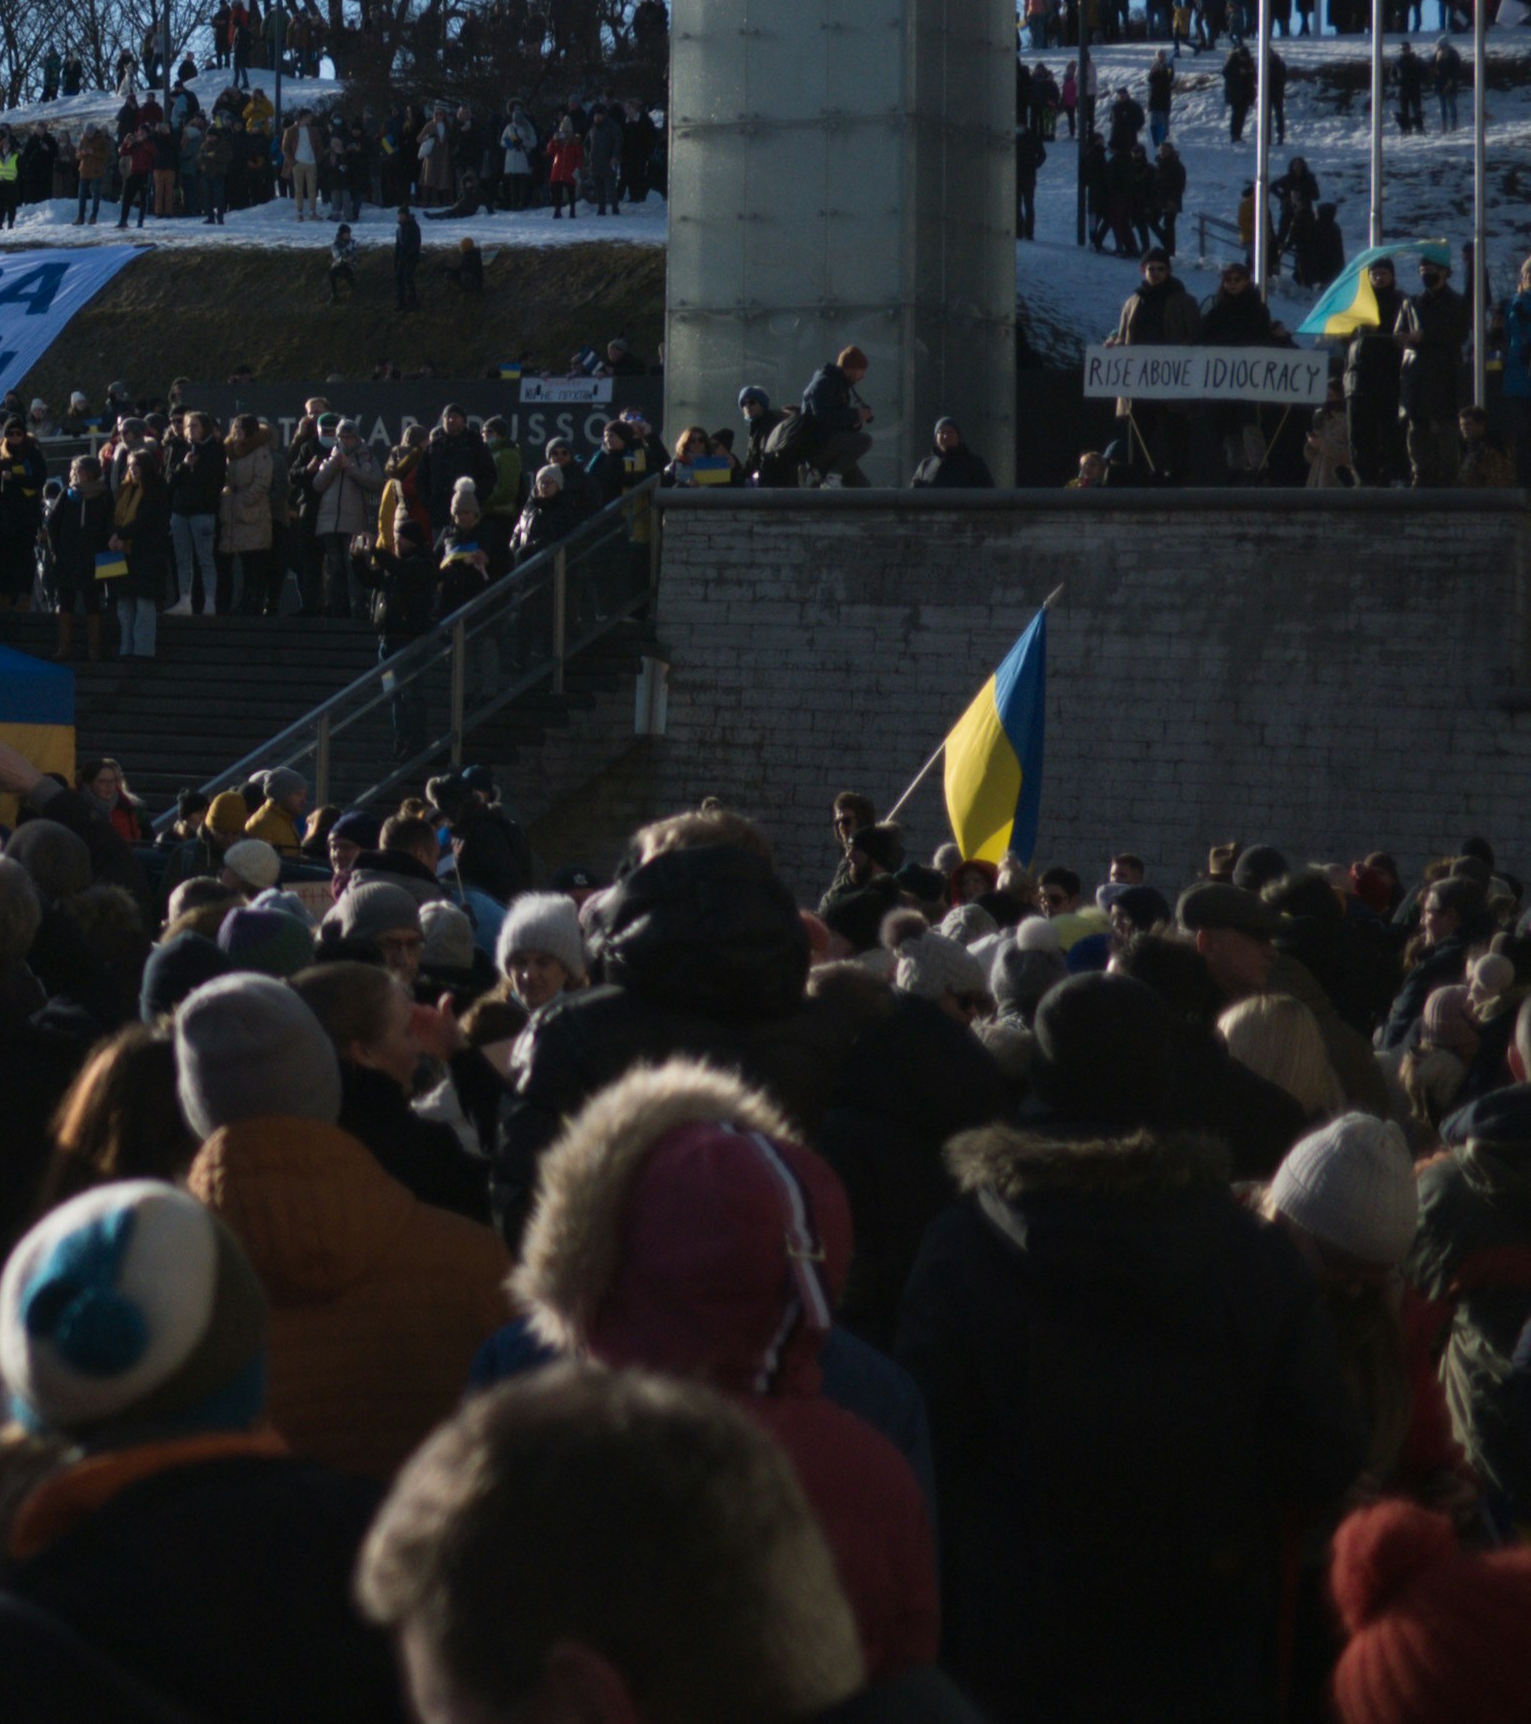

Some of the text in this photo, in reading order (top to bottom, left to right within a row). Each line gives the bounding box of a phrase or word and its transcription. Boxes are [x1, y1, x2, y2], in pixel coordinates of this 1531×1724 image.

[1088, 357, 1321, 394] RISE ABOVE IDIOCRACY
